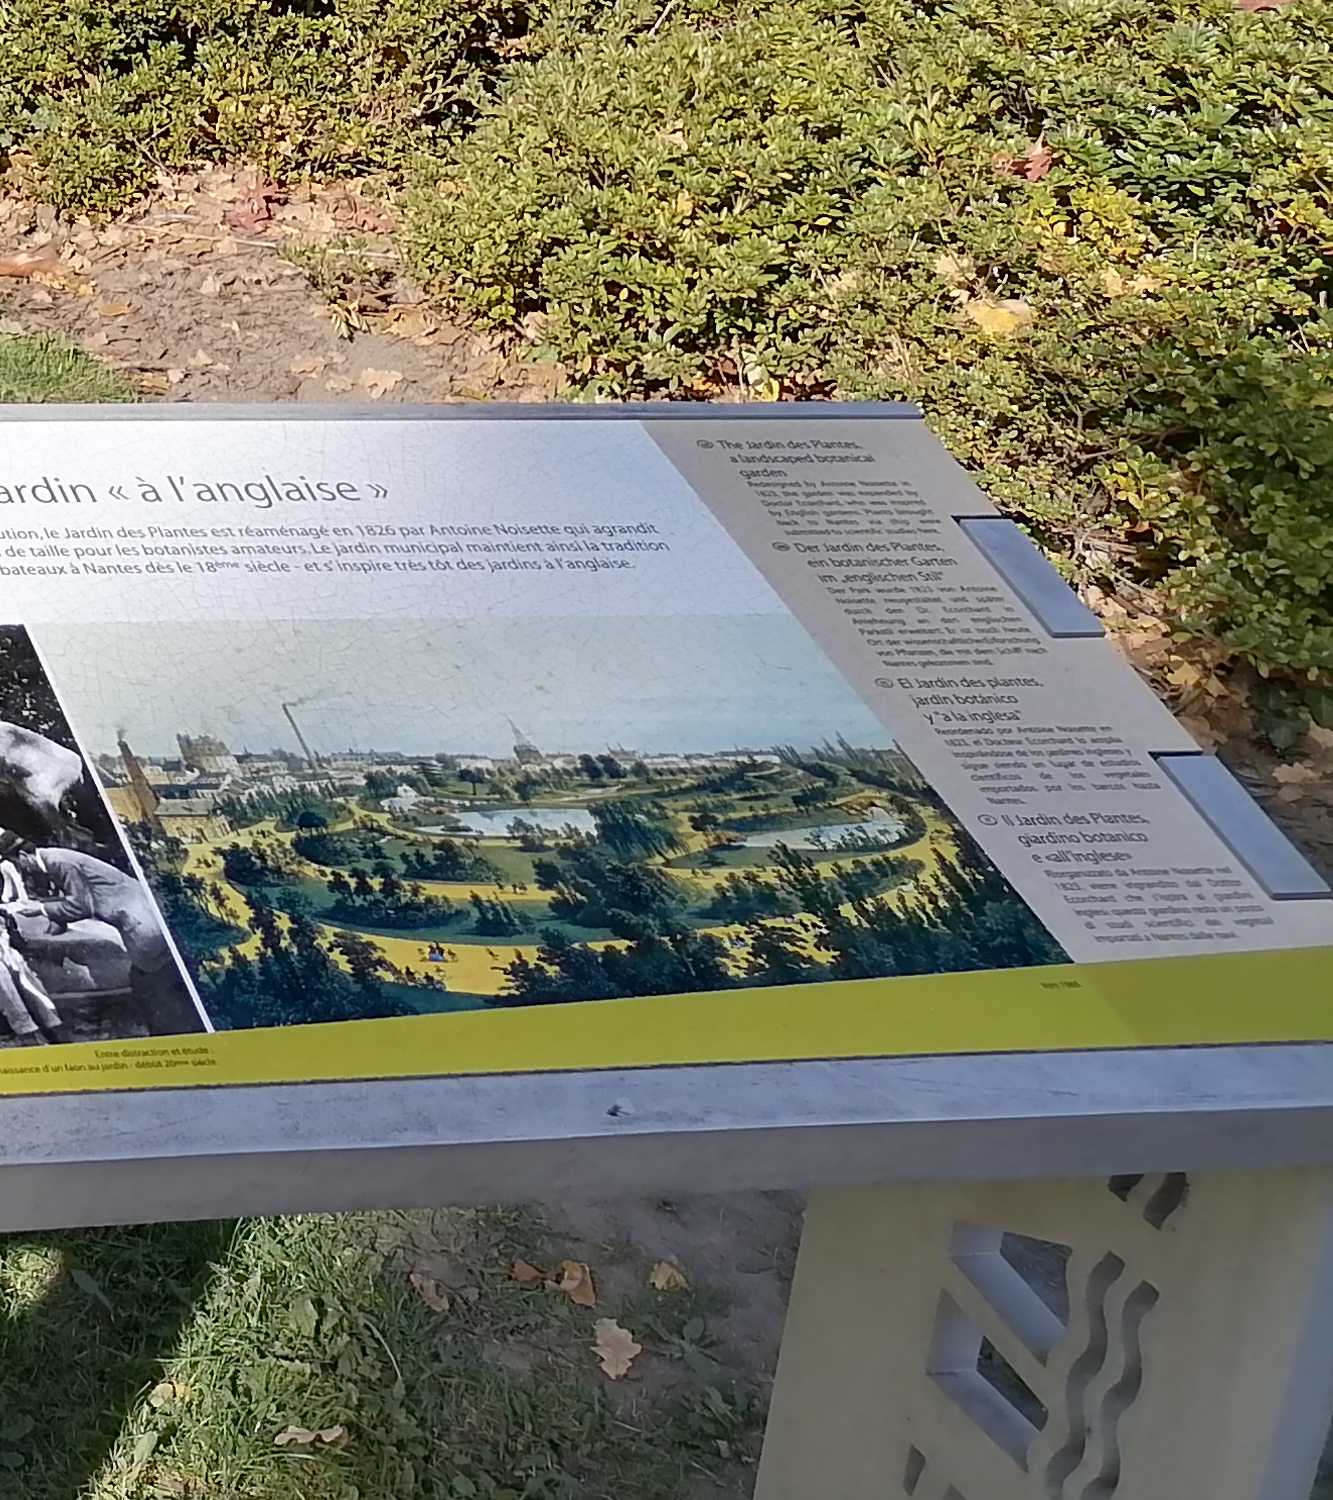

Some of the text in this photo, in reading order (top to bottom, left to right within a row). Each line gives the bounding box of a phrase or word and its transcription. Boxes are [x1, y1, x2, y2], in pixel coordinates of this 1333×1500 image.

[134, 476, 162, 502] à
[166, 474, 361, 510] l'anglaise
[43, 527, 60, 539] le
[64, 526, 113, 539] Jardin
[116, 526, 146, 538] des
[146, 525, 208, 538] Plantes
[210, 526, 236, 537] est
[237, 524, 333, 542] réaménagé
[331, 526, 354, 536] en
[354, 524, 396, 537] 1826
[397, 526, 425, 540] par
[429, 523, 493, 536] Antoine
[492, 523, 561, 535] Noisette
[563, 522, 590, 537] qui
[591, 521, 660, 537] agrandit
[4, 545, 26, 557] de
[28, 544, 70, 557] taille
[73, 546, 112, 559] pour
[114, 544, 140, 556] les
[140, 543, 228, 555] botanistes
[309, 542, 332, 554] Le
[331, 541, 382, 559] jardin
[382, 540, 463, 556] municipal
[465, 540, 544, 553] maintient
[544, 539, 583, 552] ainsi
[581, 539, 600, 551] la
[600, 539, 670, 551] tradition
[69, 563, 81, 574] à
[82, 563, 142, 574] Nantes
[144, 562, 175, 573] dès
[174, 562, 194, 573] le
[243, 560, 291, 572] siècle
[303, 561, 323, 572] et
[393, 559, 427, 572] très
[427, 559, 454, 571] tôt
[452, 558, 485, 570] des
[484, 558, 542, 573] jardins
[542, 557, 555, 569] à
[554, 557, 636, 572] l'anglaise.
